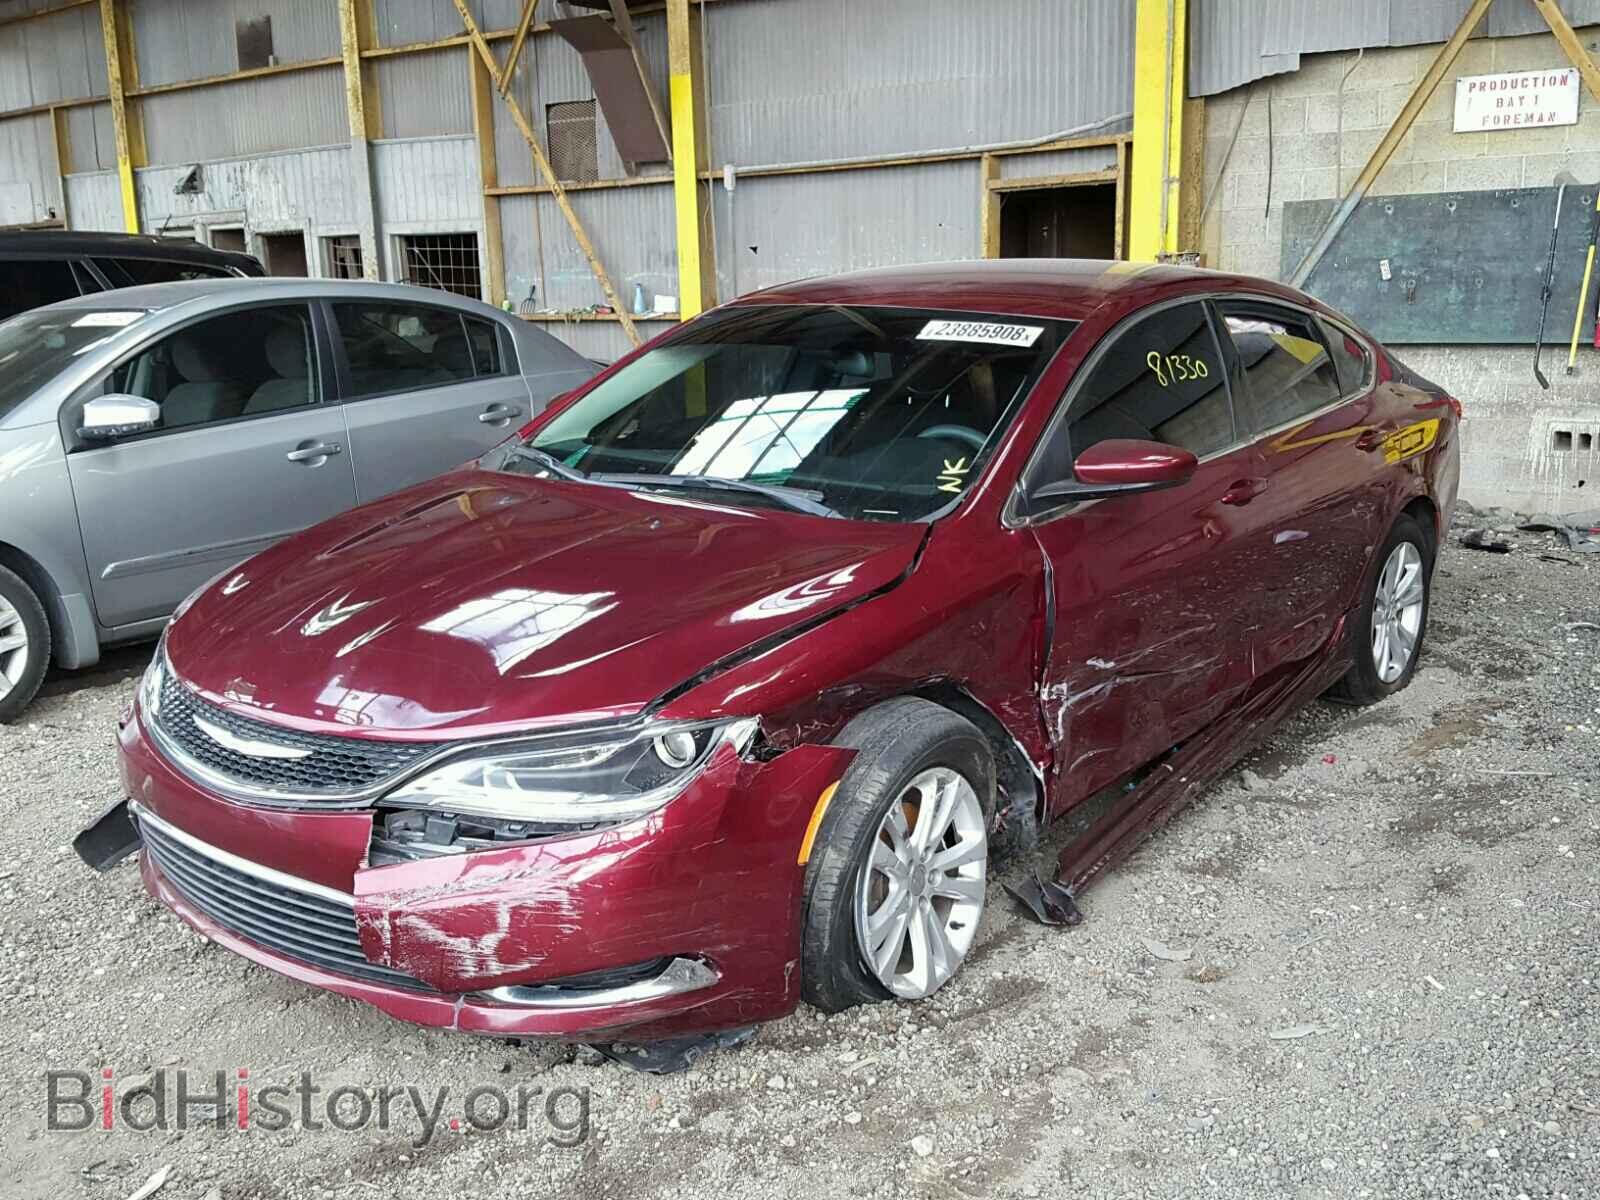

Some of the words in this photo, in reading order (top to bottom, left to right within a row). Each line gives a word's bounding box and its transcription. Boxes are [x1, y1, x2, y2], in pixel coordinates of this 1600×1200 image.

[1468, 74, 1569, 93] PRODUCTION
[1496, 95, 1527, 109] BAY
[1482, 111, 1556, 127] FOREMAN
[935, 322, 1026, 341] 23885908
[1146, 351, 1208, 387] 81330
